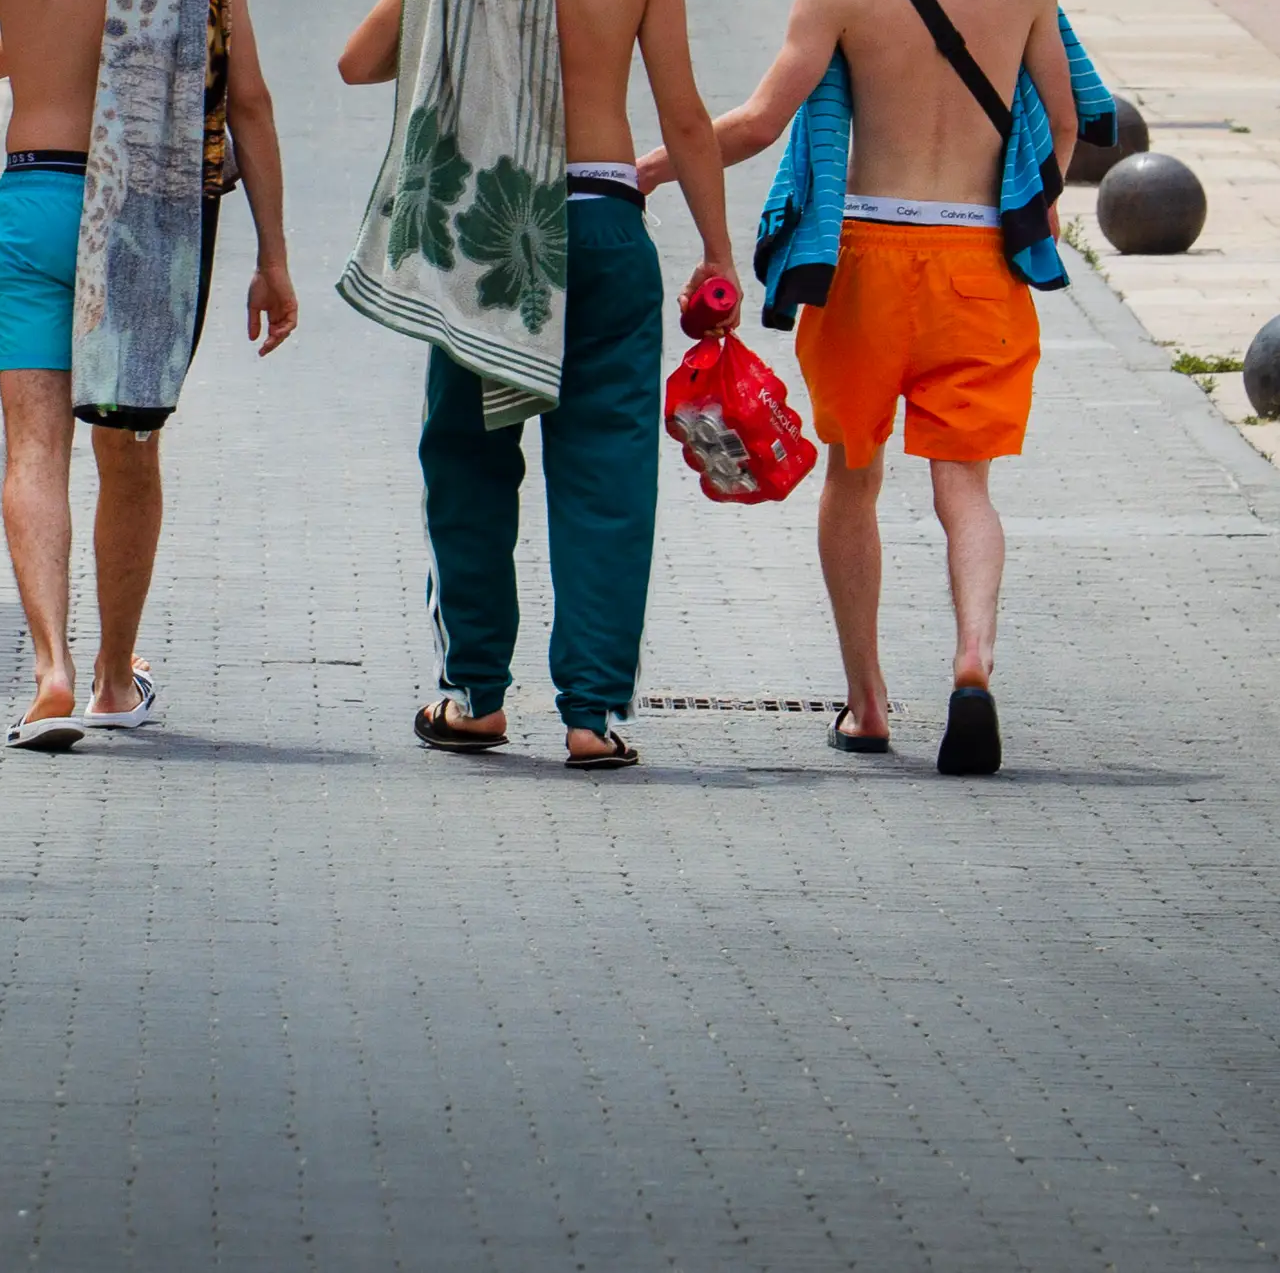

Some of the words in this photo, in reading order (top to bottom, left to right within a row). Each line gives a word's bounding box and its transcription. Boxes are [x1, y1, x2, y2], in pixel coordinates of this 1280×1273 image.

[9, 153, 35, 164] OSS
[580, 170, 610, 178] Calvin
[940, 209, 966, 219] Calvin
